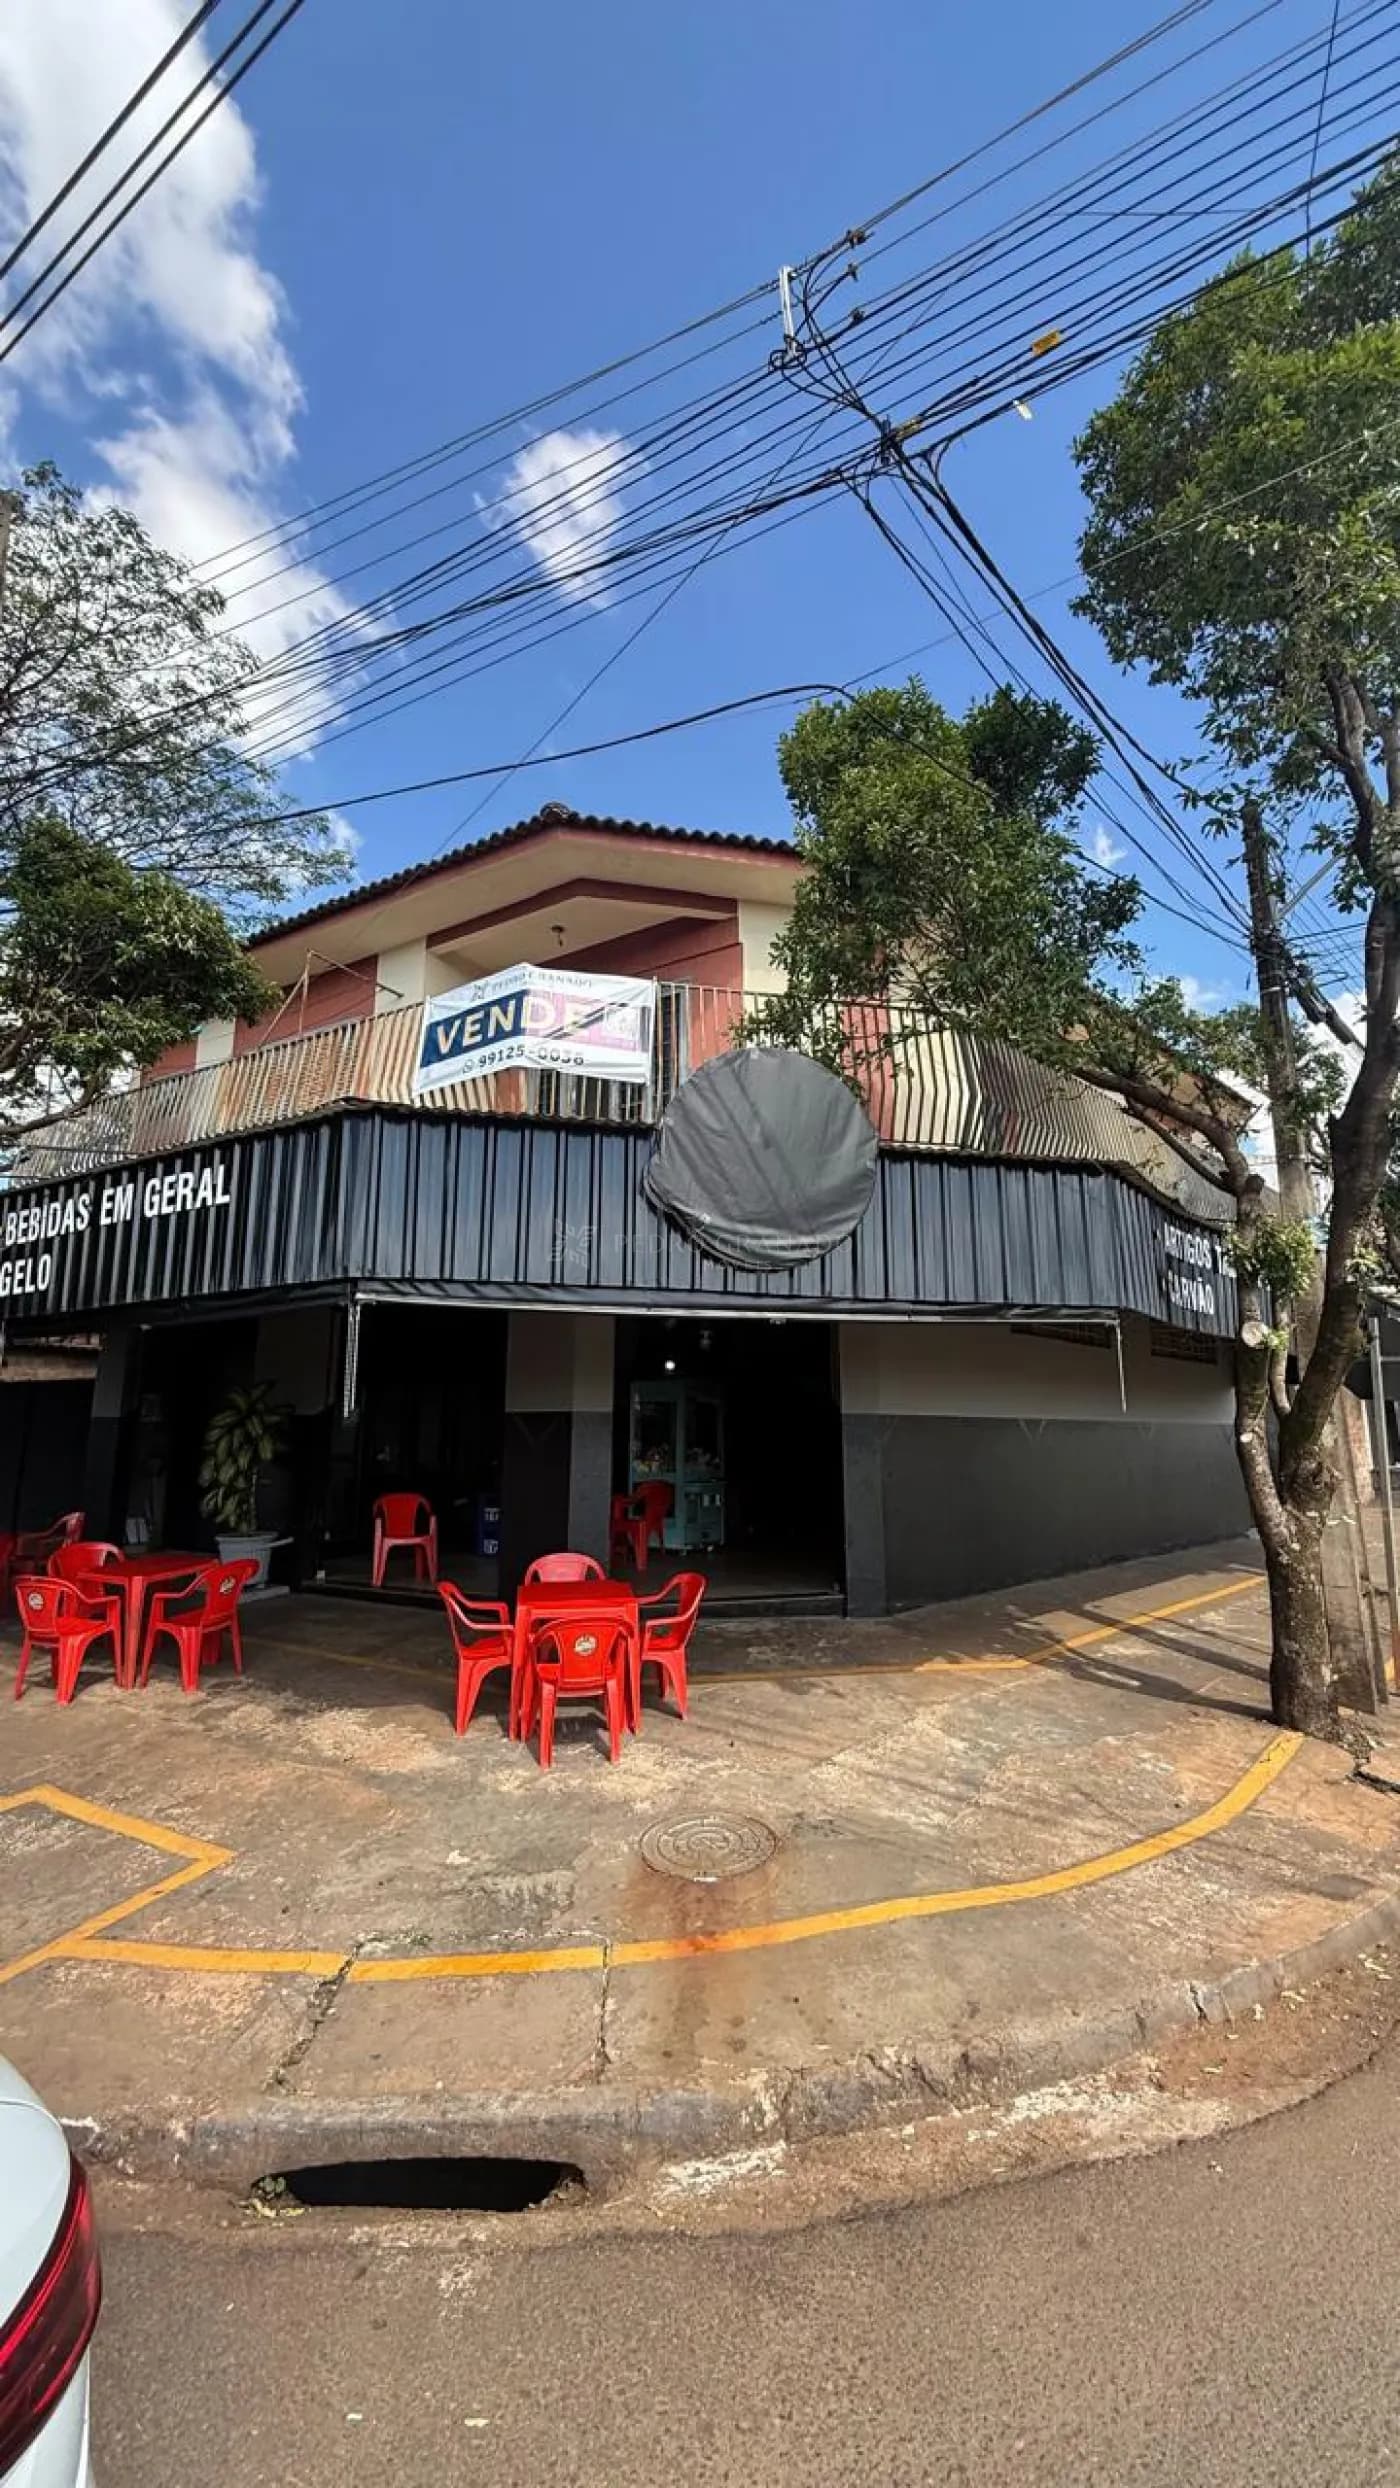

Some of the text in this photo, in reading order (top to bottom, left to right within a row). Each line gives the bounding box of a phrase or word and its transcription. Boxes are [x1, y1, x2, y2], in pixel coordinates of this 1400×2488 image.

[5, 1164, 231, 1247] BEBIDAS EM GERAL
[0, 1253, 52, 1298] GELO
